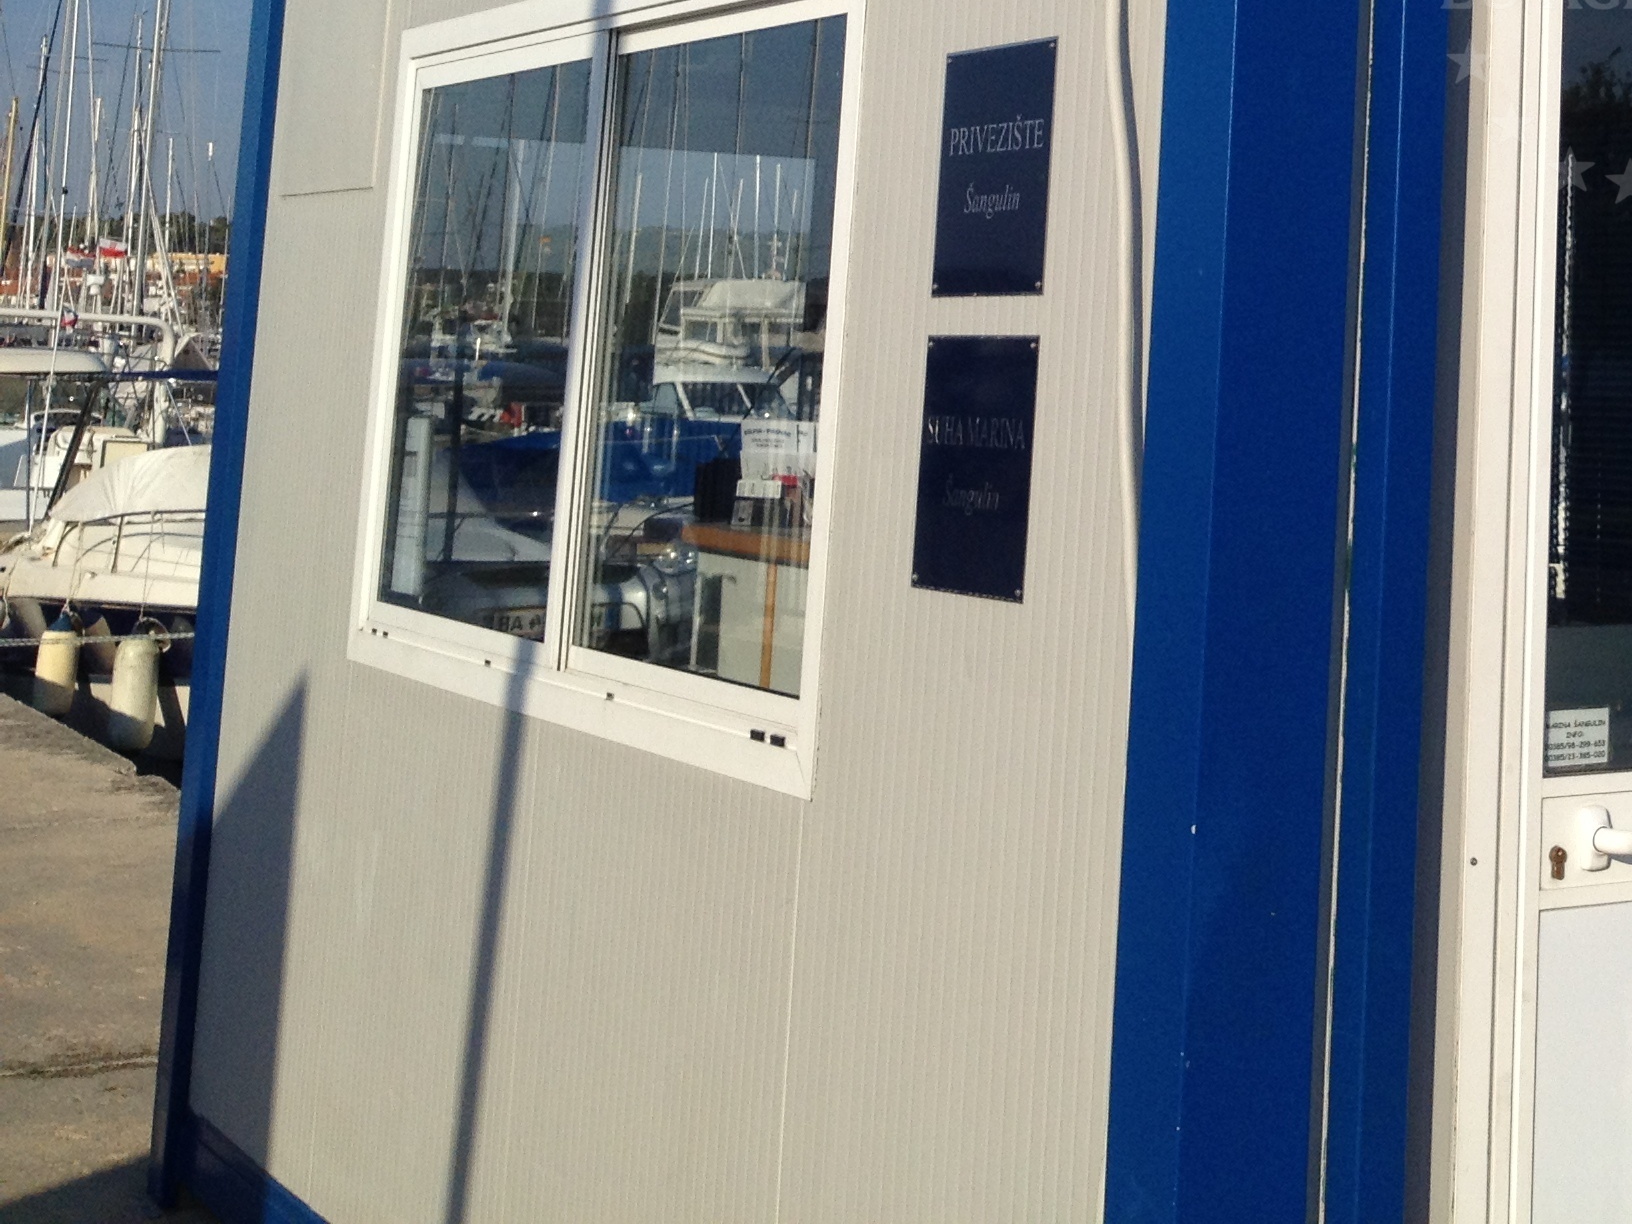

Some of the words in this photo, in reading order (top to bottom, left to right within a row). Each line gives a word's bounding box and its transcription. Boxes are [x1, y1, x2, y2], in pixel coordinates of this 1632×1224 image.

[949, 113, 1045, 156] PRIVEZIŠTE
[963, 182, 1021, 219] Šangulin
[967, 416, 1026, 450] MARINA
